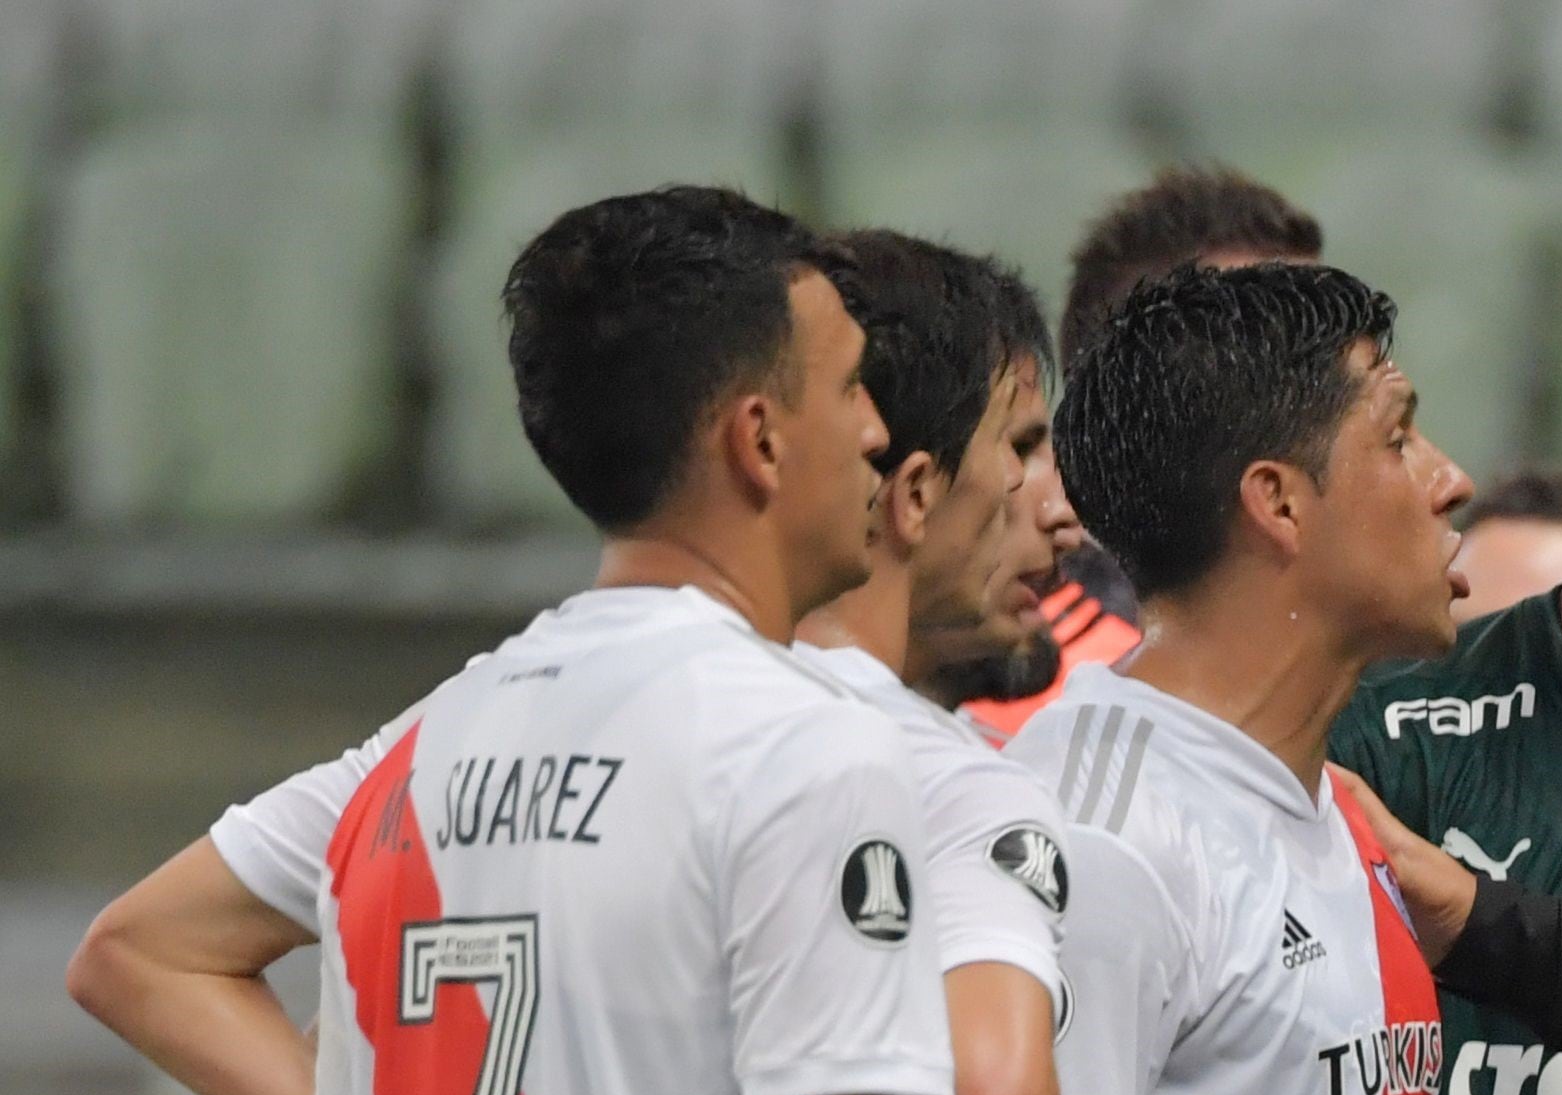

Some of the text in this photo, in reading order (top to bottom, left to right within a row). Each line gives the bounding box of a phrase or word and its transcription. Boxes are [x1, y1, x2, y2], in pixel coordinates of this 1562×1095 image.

[369, 754, 624, 860] M. SUAREZ
[1282, 940, 1327, 970] adidas
